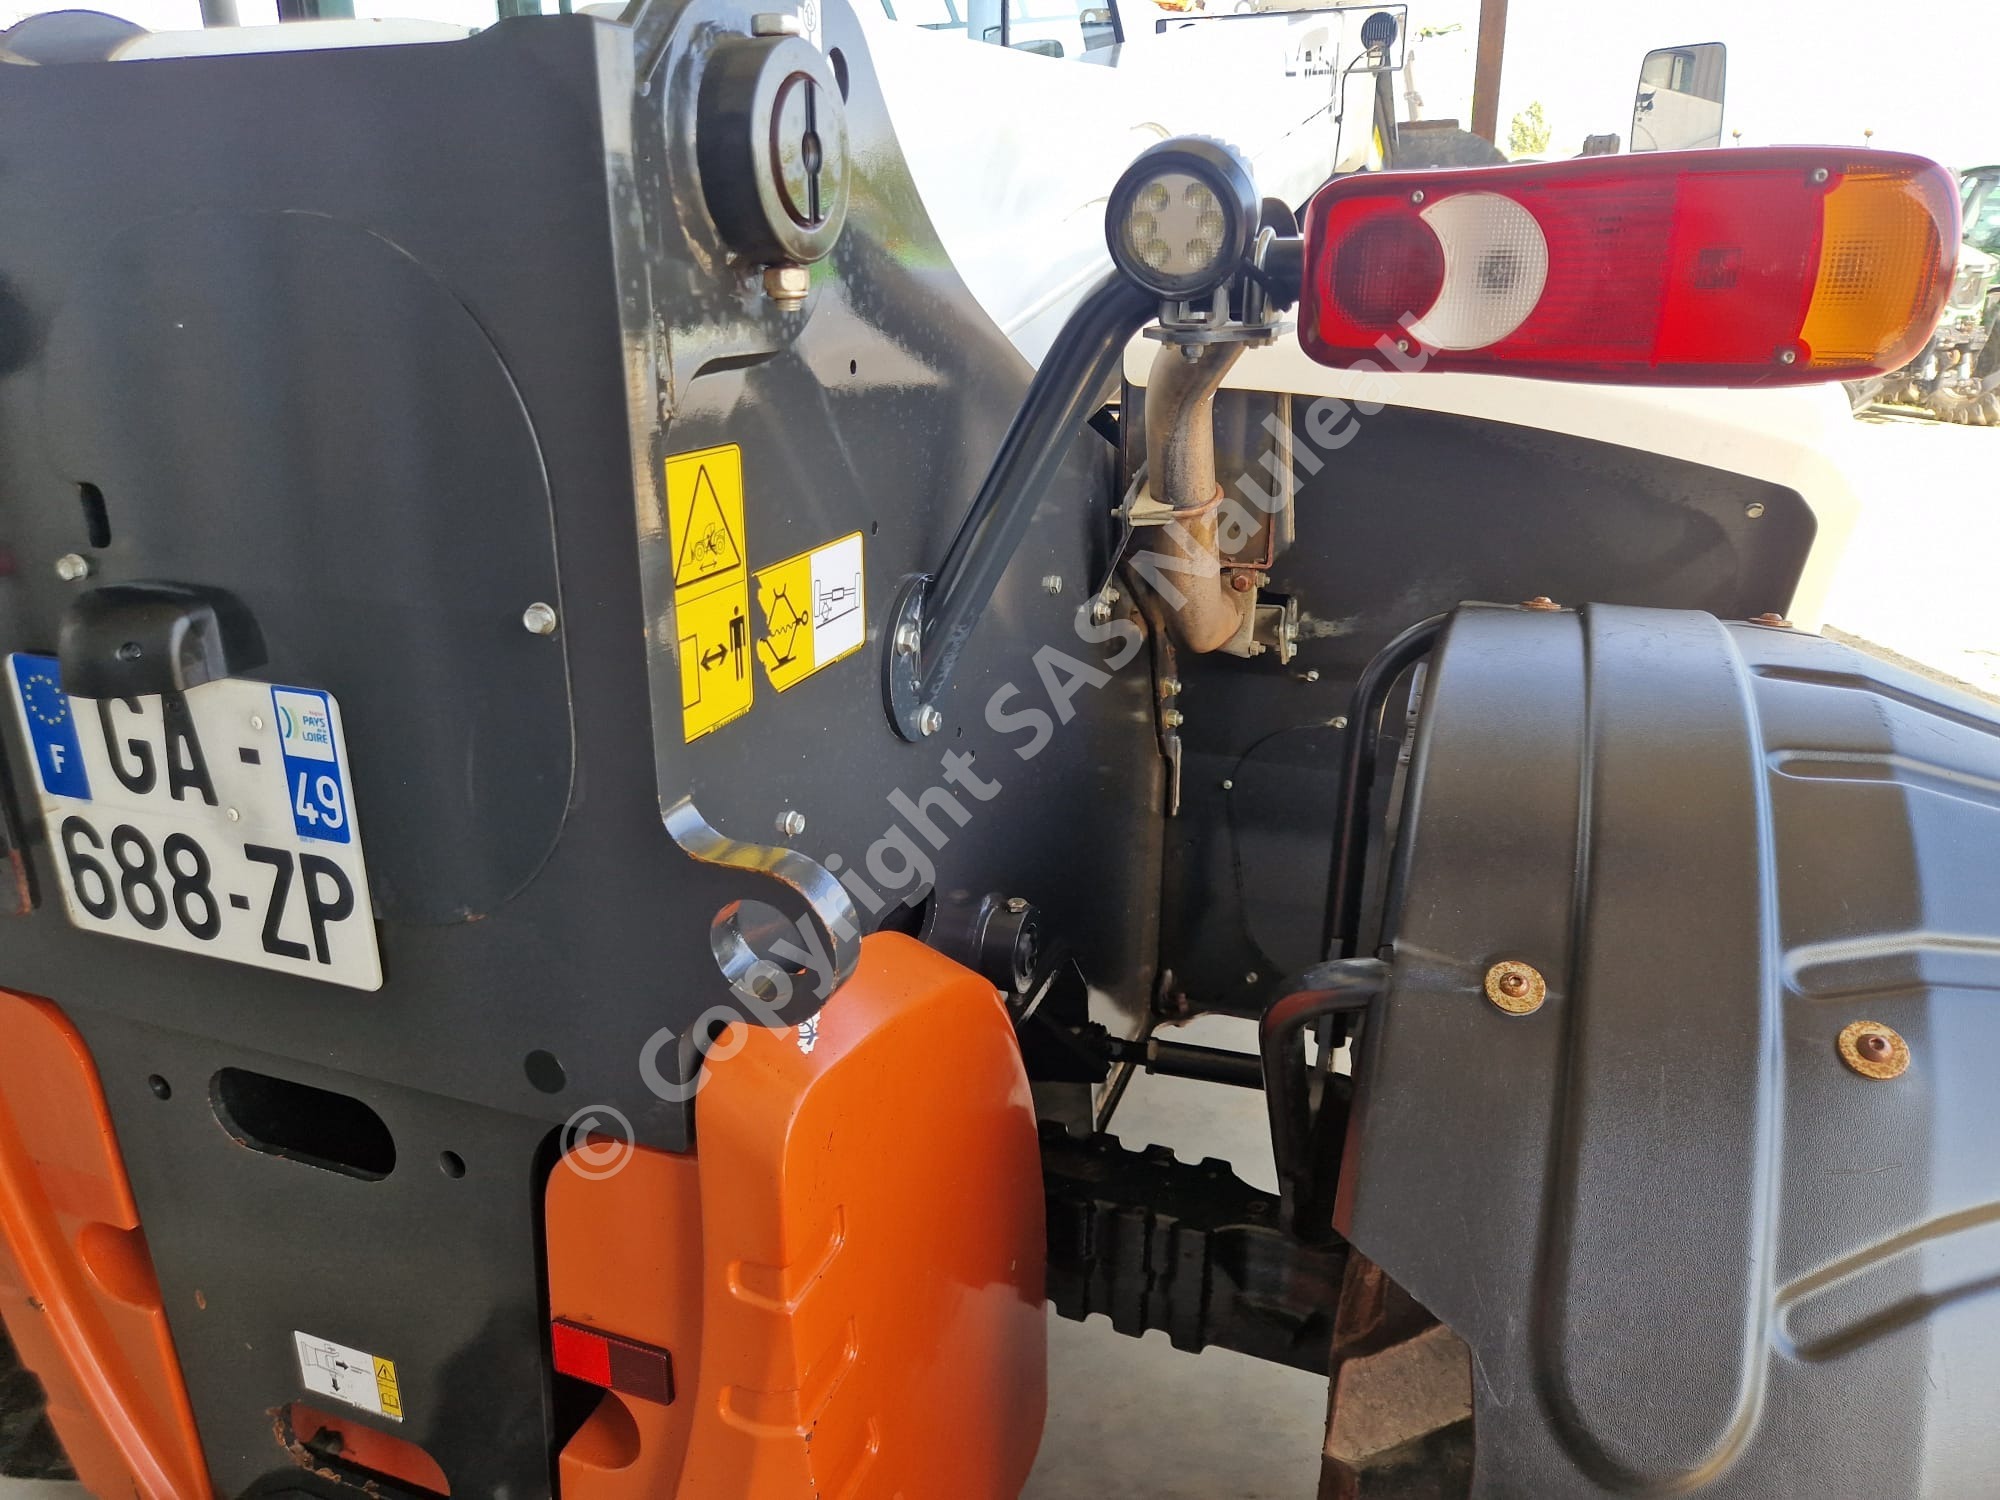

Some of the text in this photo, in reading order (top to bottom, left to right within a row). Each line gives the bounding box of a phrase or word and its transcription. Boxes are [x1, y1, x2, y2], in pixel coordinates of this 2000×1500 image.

[302, 715, 326, 728] PAYS
[302, 730, 328, 745] LOIRE
[50, 744, 66, 774] F
[296, 771, 344, 829] 49
[61, 815, 354, 965] 688-ZP
